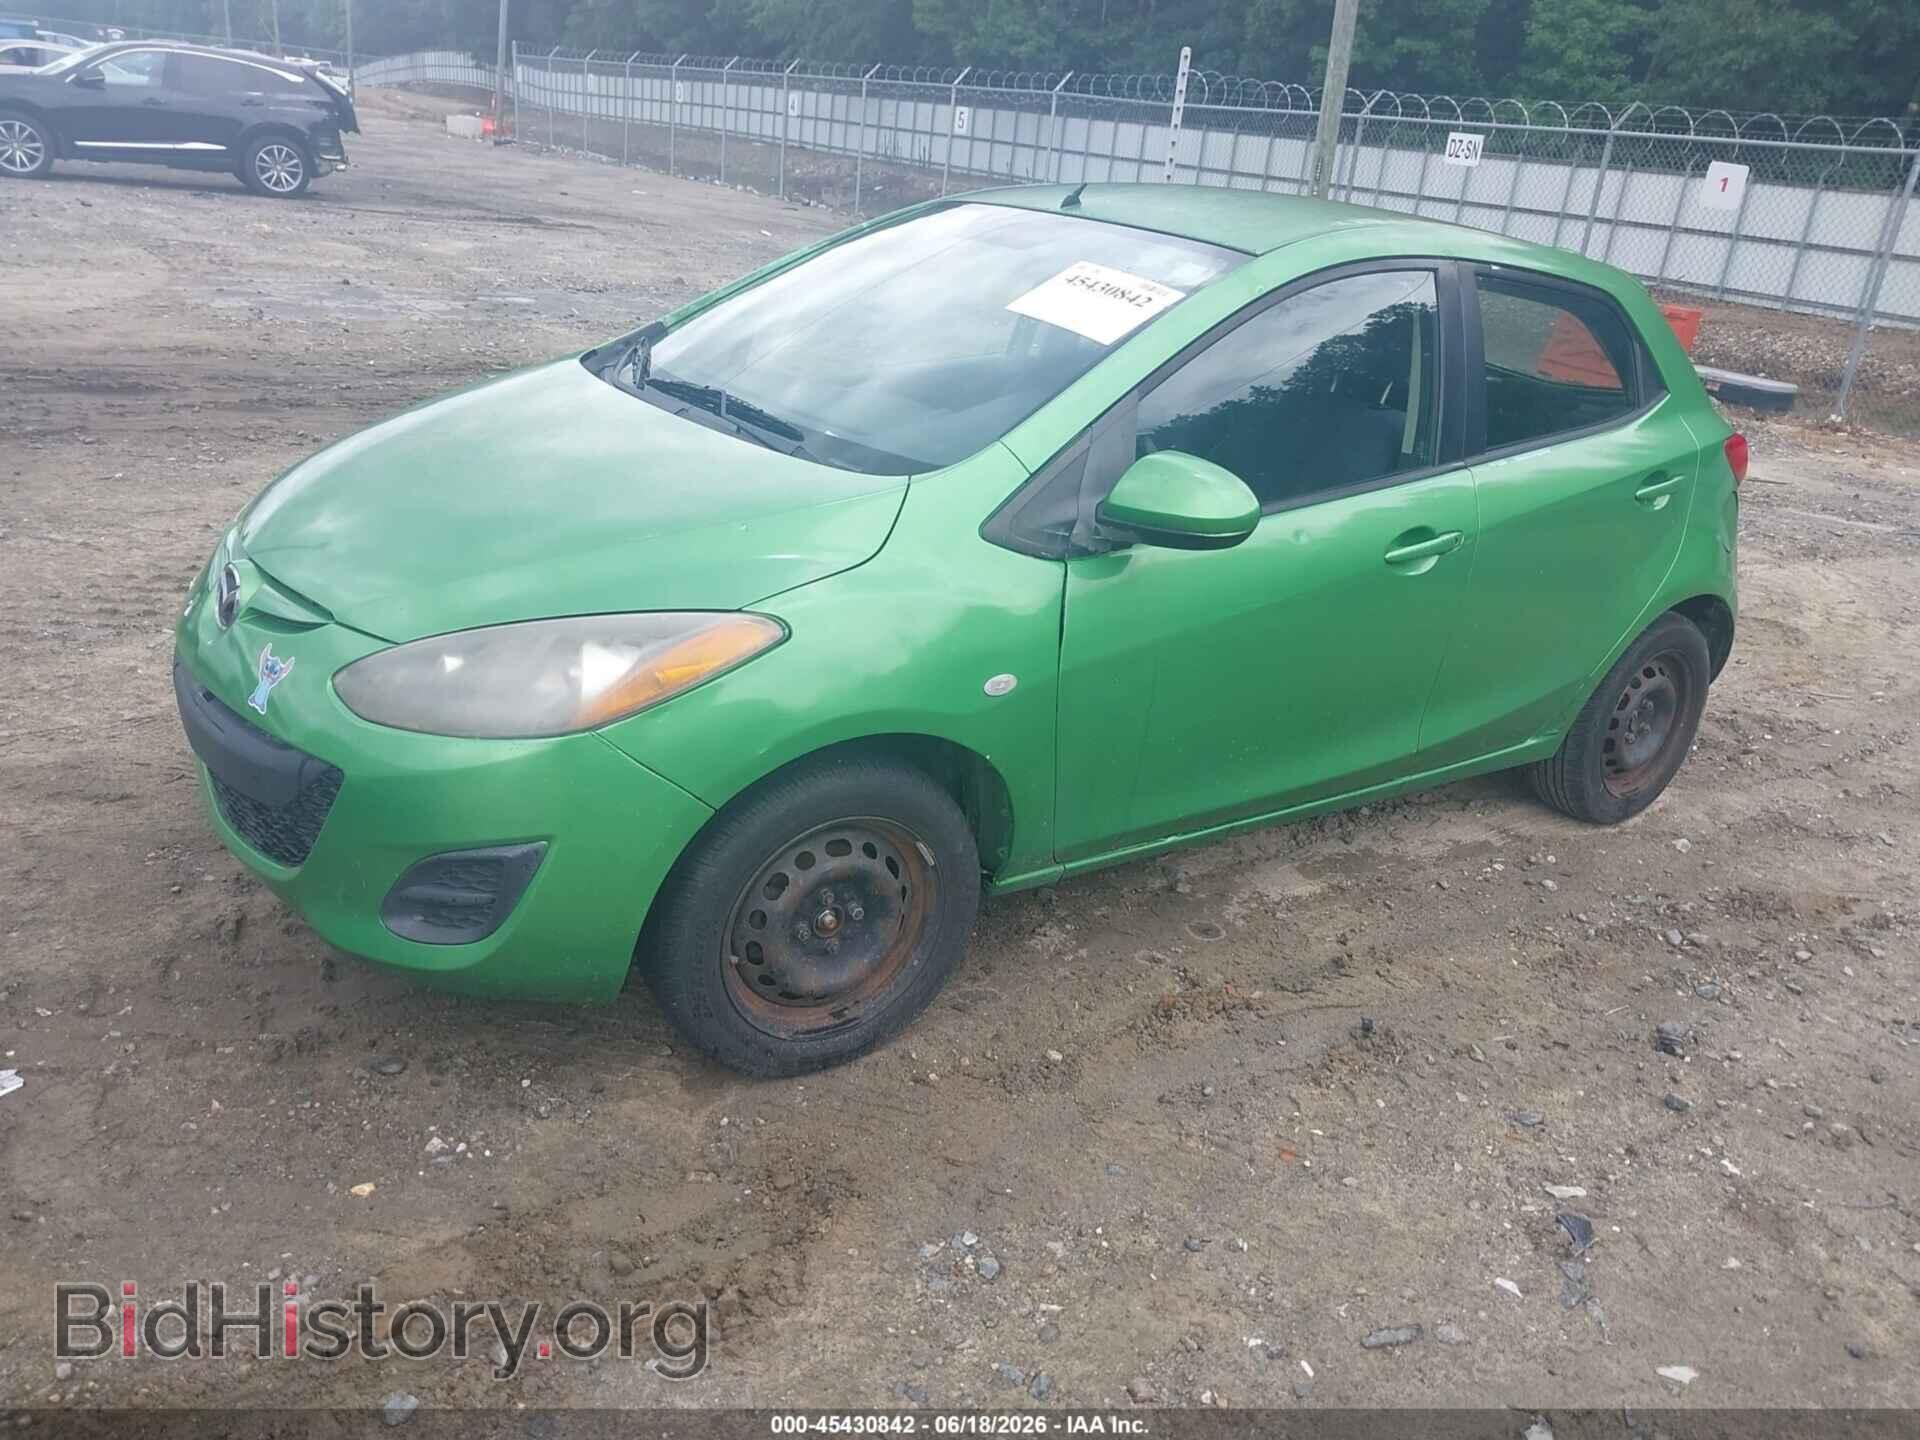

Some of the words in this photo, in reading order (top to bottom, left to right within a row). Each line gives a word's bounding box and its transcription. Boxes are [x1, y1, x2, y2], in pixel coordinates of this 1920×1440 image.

[958, 111, 965, 129] 5
[1448, 139, 1481, 160] DZ-SN
[1720, 176, 1729, 193] 1
[1065, 274, 1153, 308] 45430842
